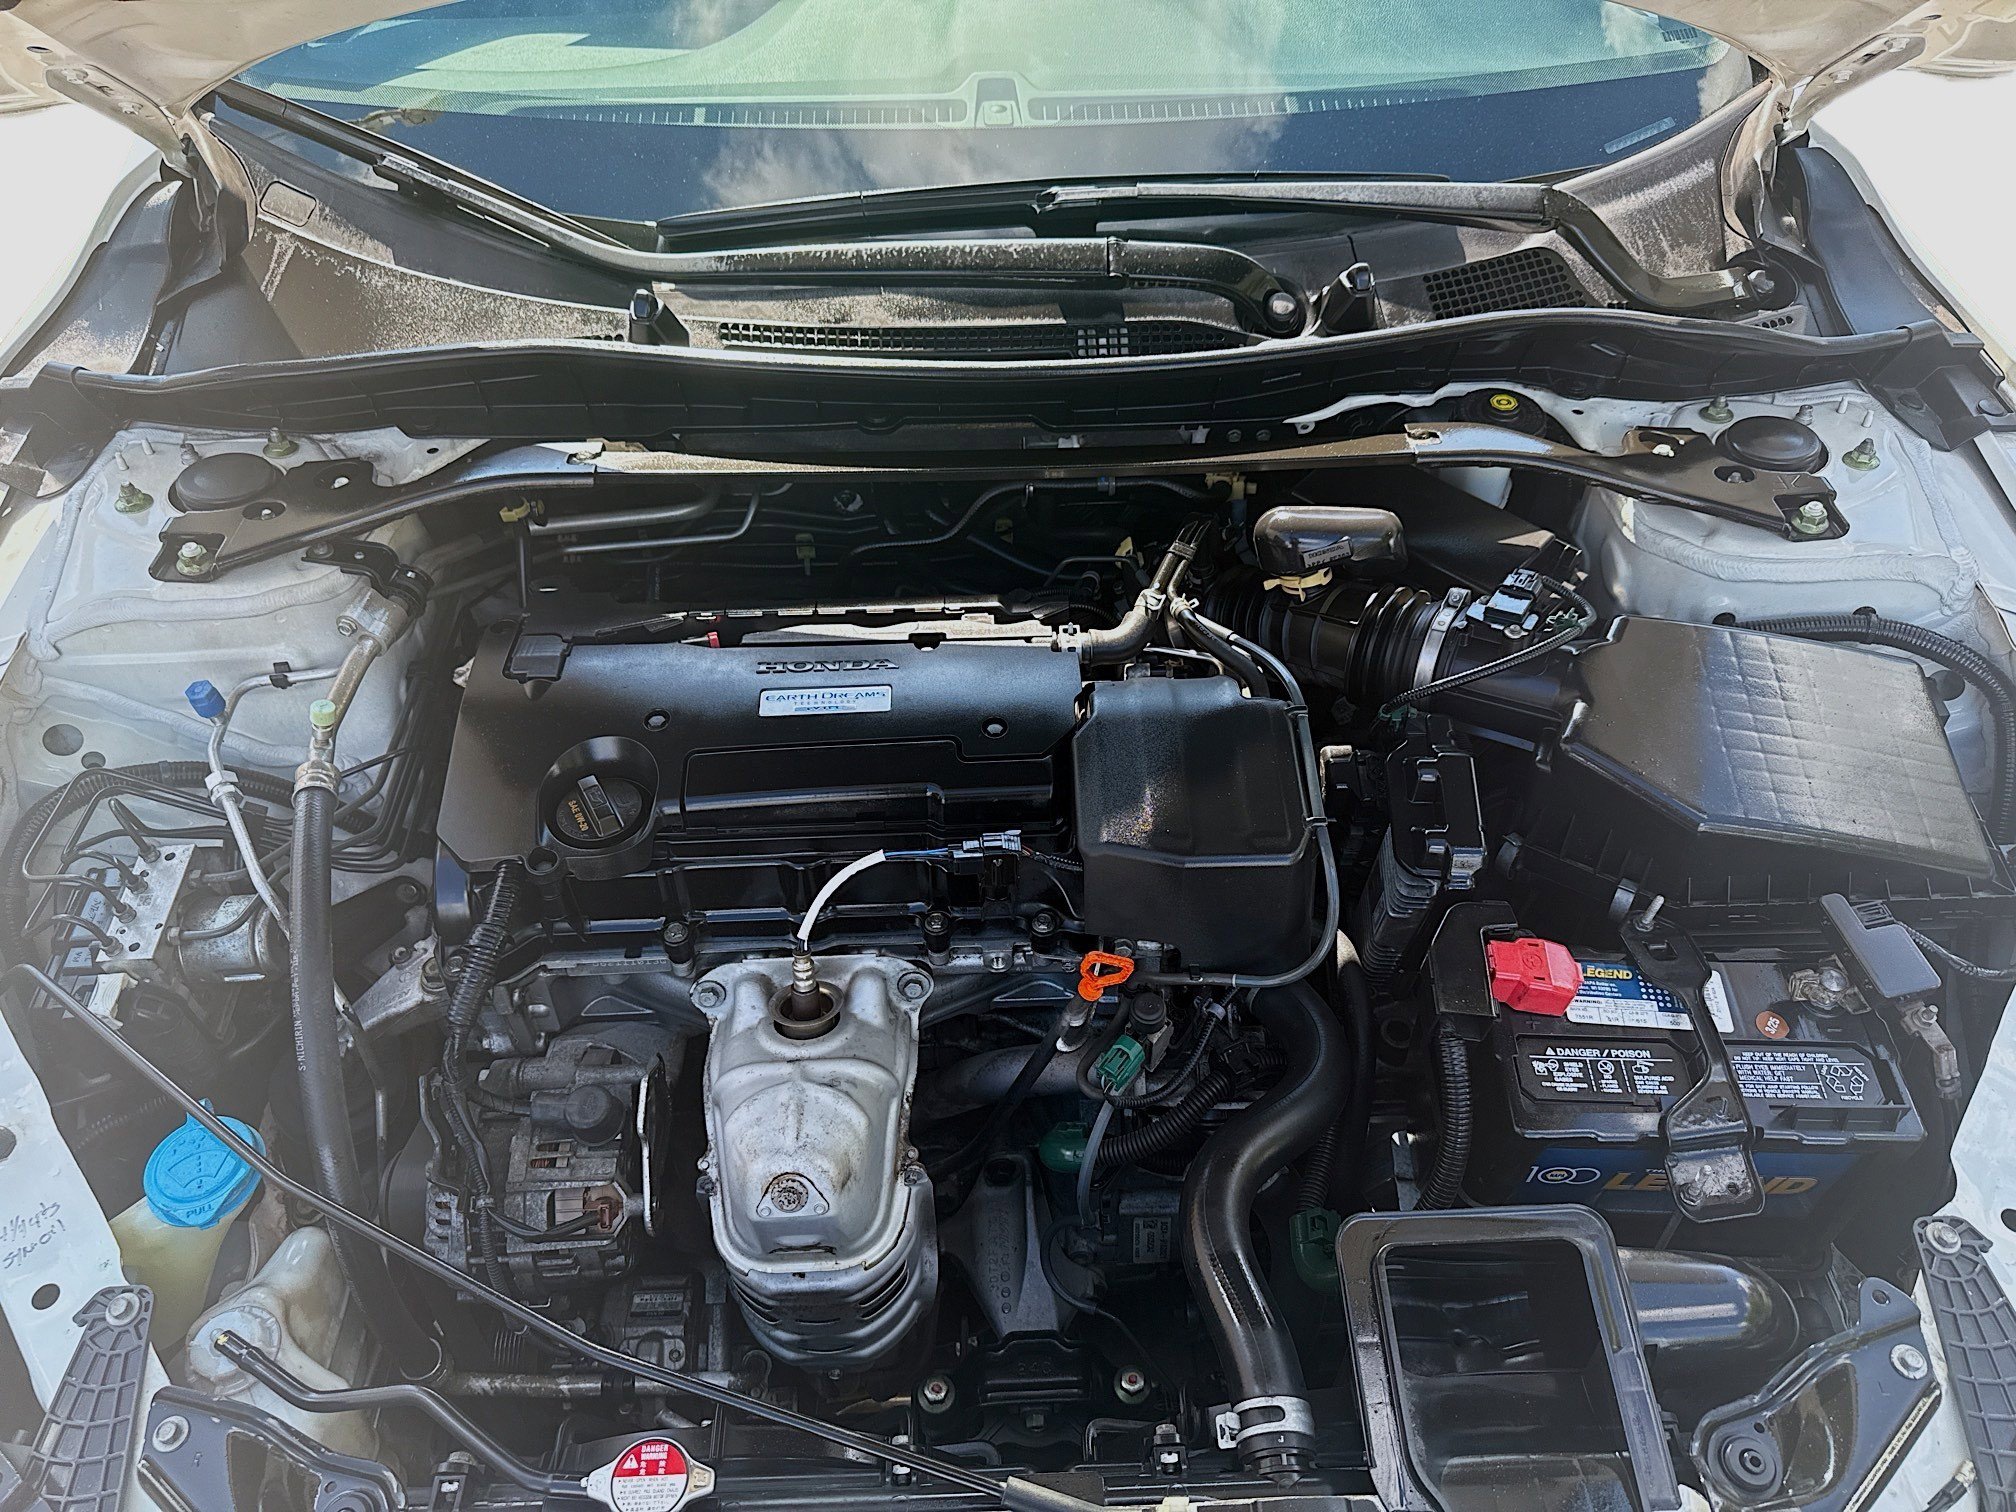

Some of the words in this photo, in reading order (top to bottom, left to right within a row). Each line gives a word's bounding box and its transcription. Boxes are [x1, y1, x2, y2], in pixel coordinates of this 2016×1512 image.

[756, 659, 900, 674] HONDA
[765, 693, 818, 701] EARTH
[820, 690, 887, 701] DREAMS
[568, 799, 581, 815] SAE
[574, 812, 590, 833] 0W-20
[1764, 1016, 1780, 1034] 3/25
[1556, 1048, 1600, 1057] DANGER
[1611, 1049, 1651, 1059] POISON
[1601, 1172, 1817, 1195] LEND
[185, 1203, 215, 1218] PULL
[641, 1444, 669, 1452] DANGER
